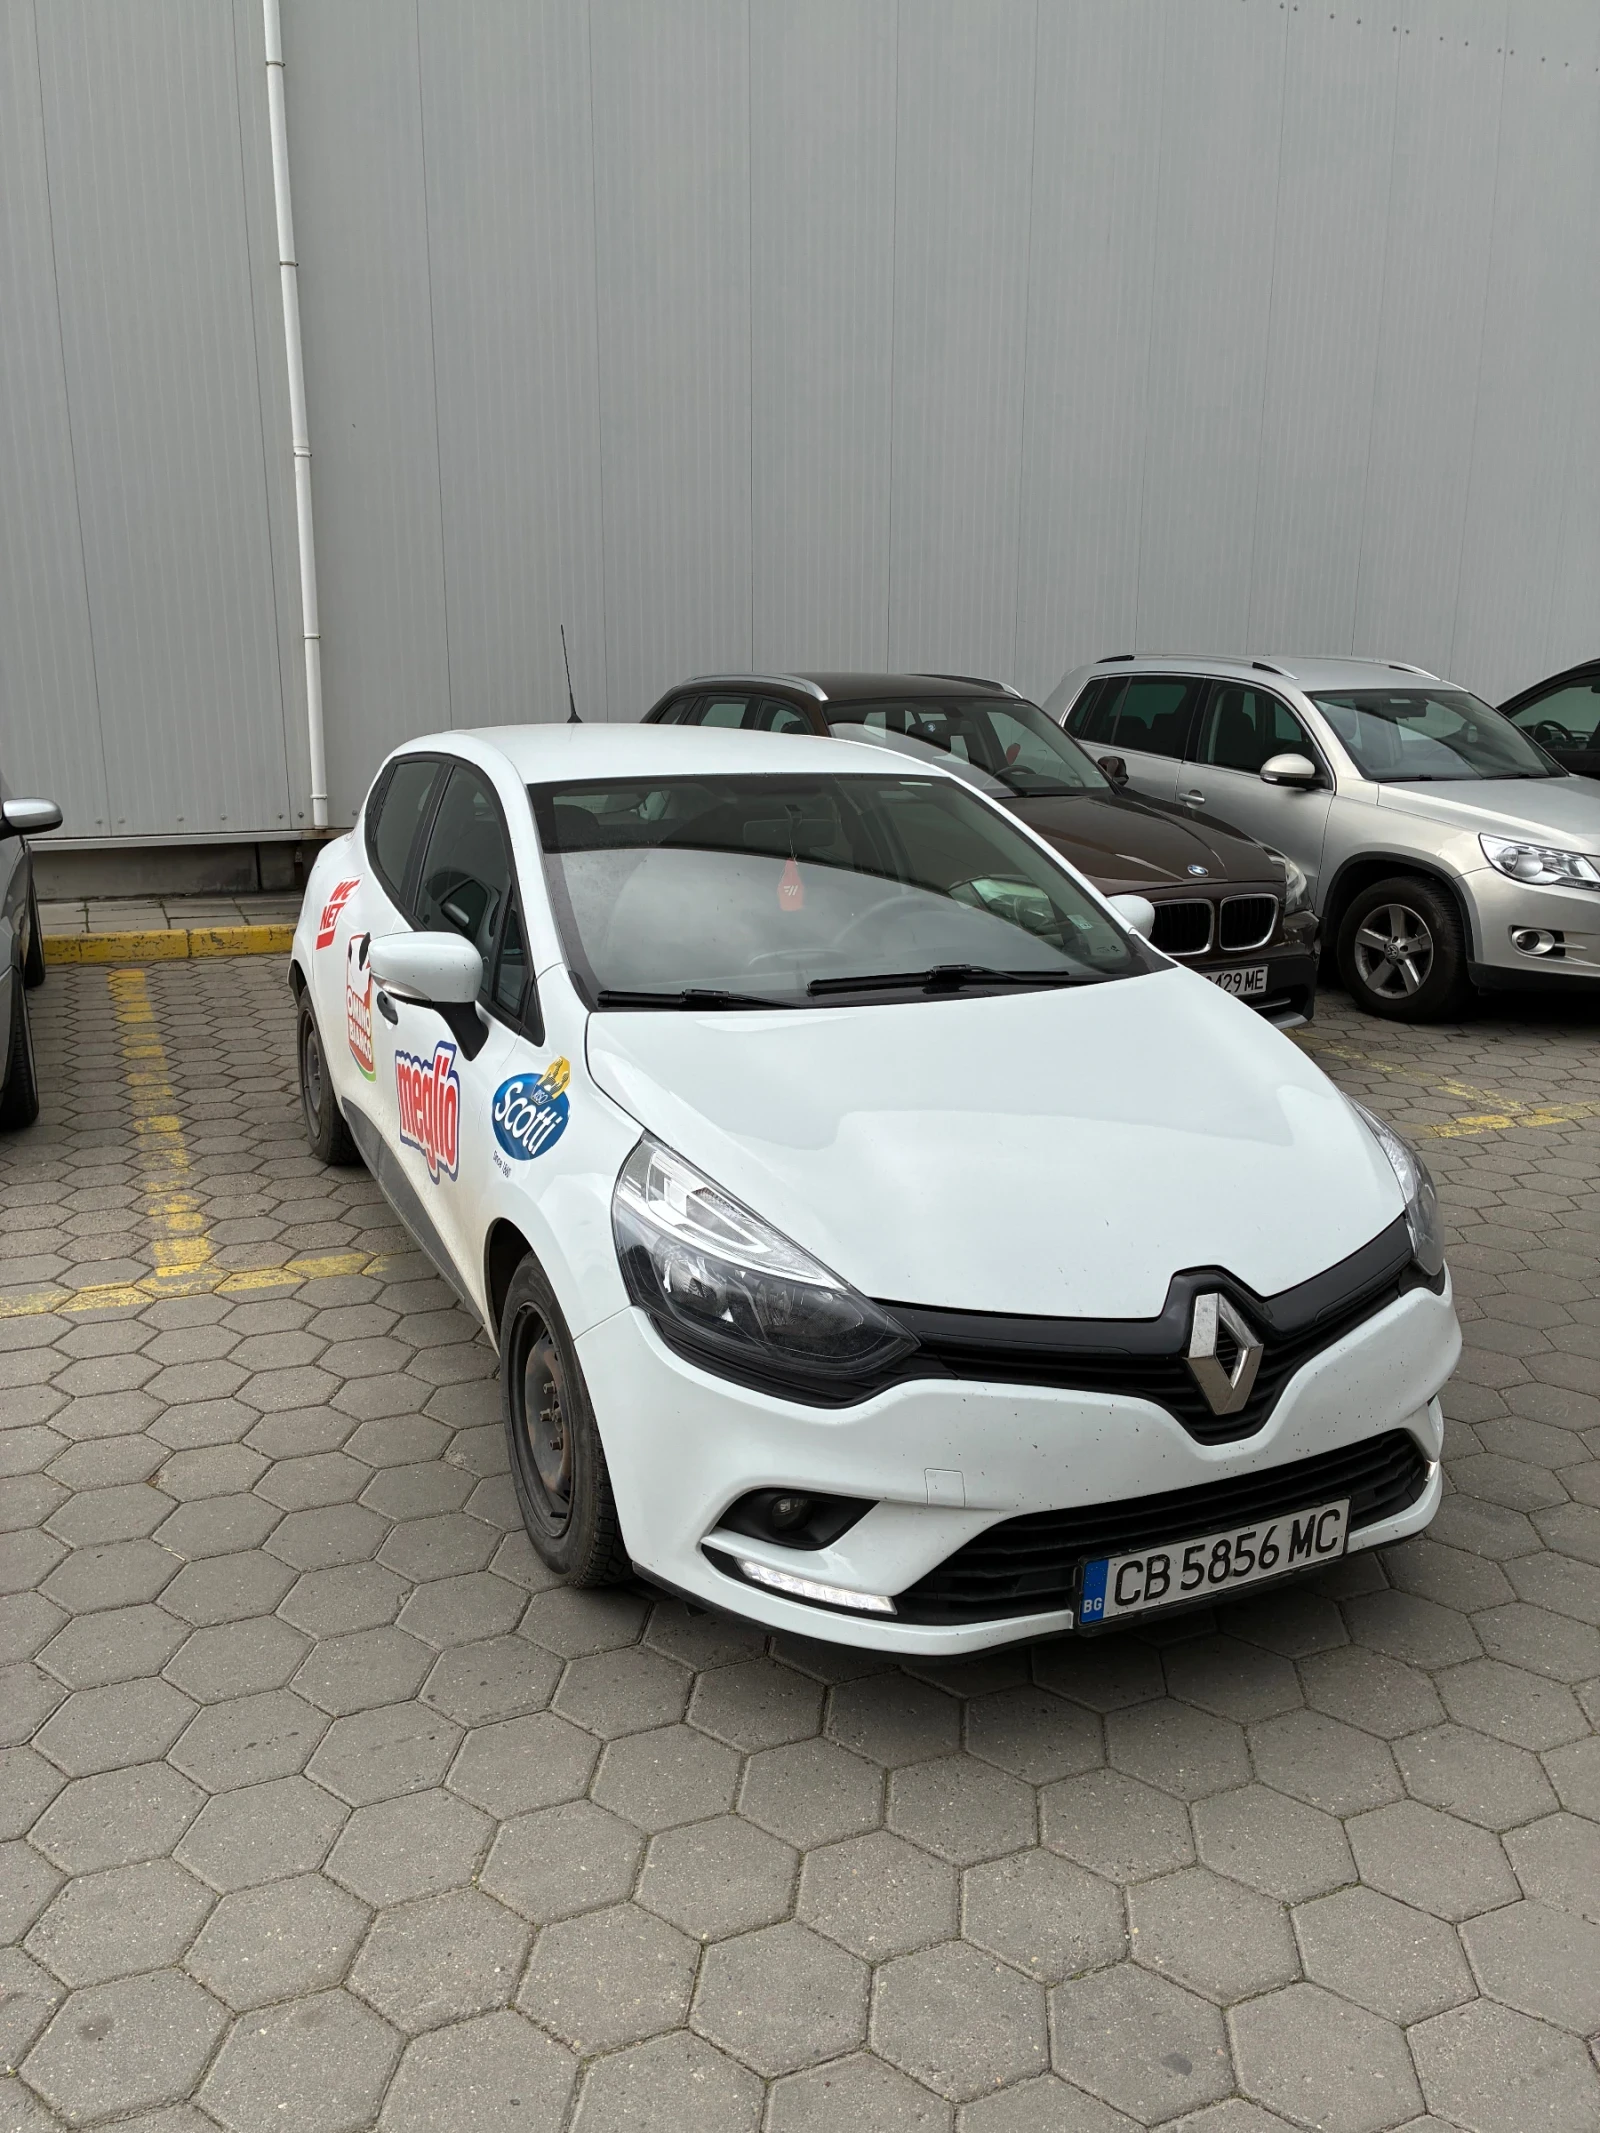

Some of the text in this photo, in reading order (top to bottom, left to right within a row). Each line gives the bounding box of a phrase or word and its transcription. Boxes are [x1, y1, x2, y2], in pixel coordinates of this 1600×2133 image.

[329, 879, 361, 902] WC
[320, 902, 346, 931] NET
[1244, 969, 1264, 991] ME
[396, 1053, 457, 1172] meglio
[495, 1081, 563, 1155] Scotti
[1083, 1508, 1341, 1614] BG CB 5856 MC
